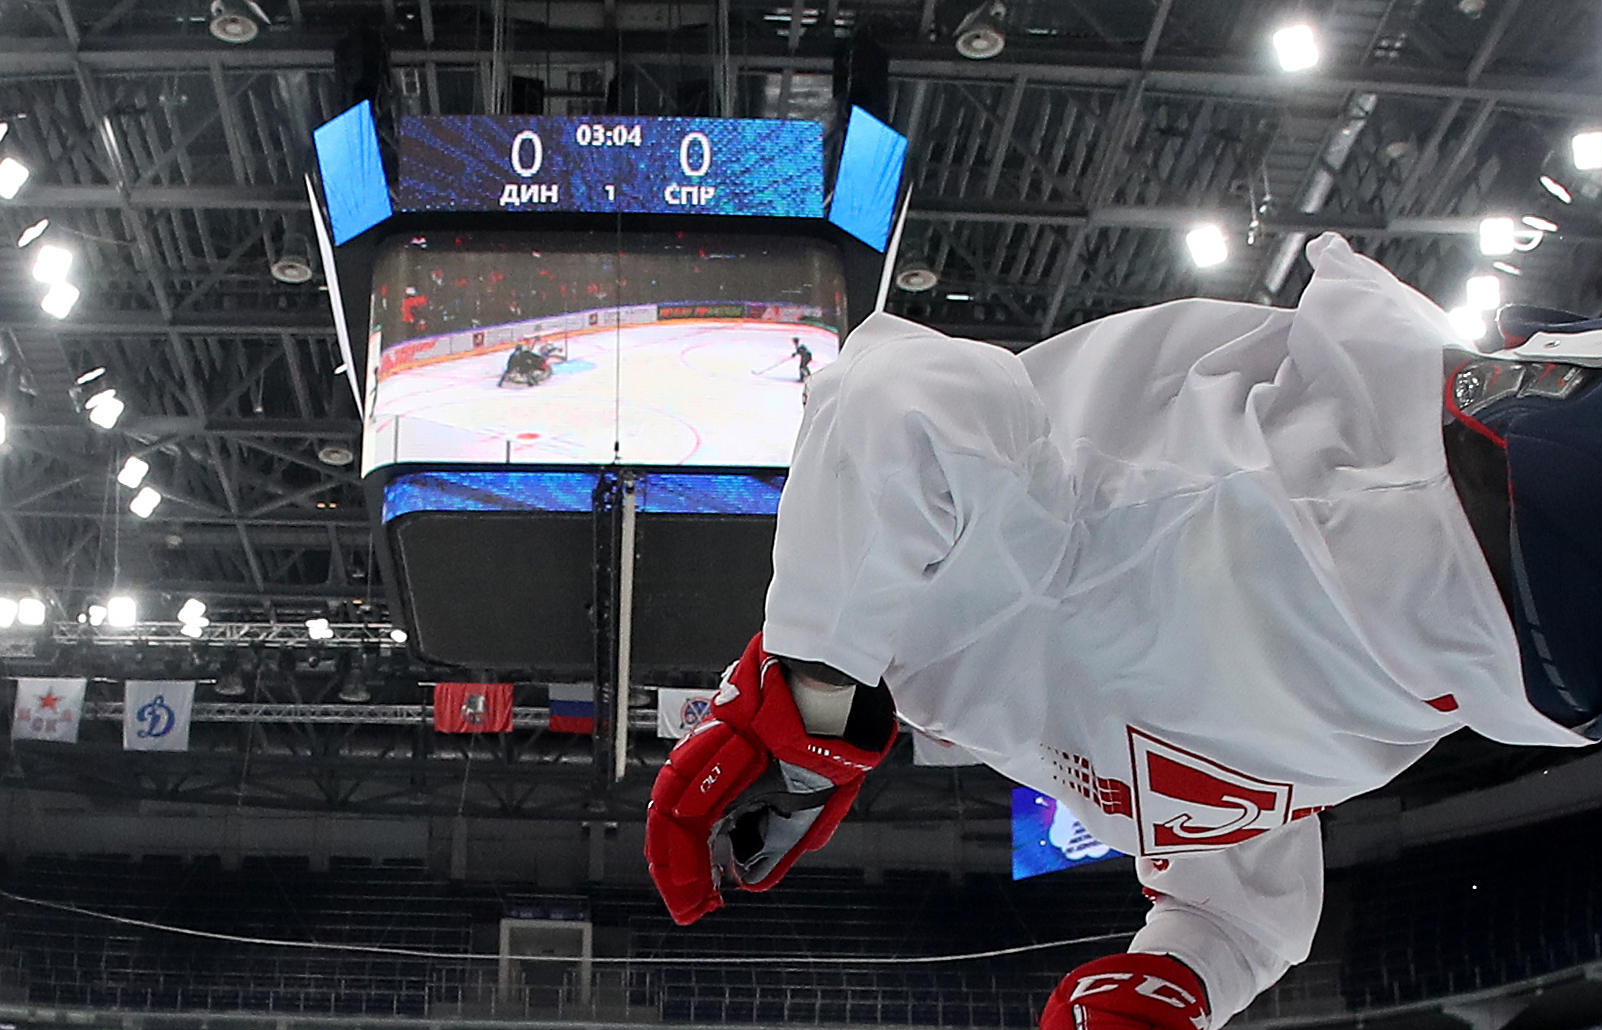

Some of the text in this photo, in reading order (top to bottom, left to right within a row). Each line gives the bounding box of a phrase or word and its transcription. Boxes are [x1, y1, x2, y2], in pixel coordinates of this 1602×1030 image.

[510, 124, 712, 178] 0 03:04 0
[499, 182, 560, 207] ДИН
[663, 184, 717, 207] СПР
